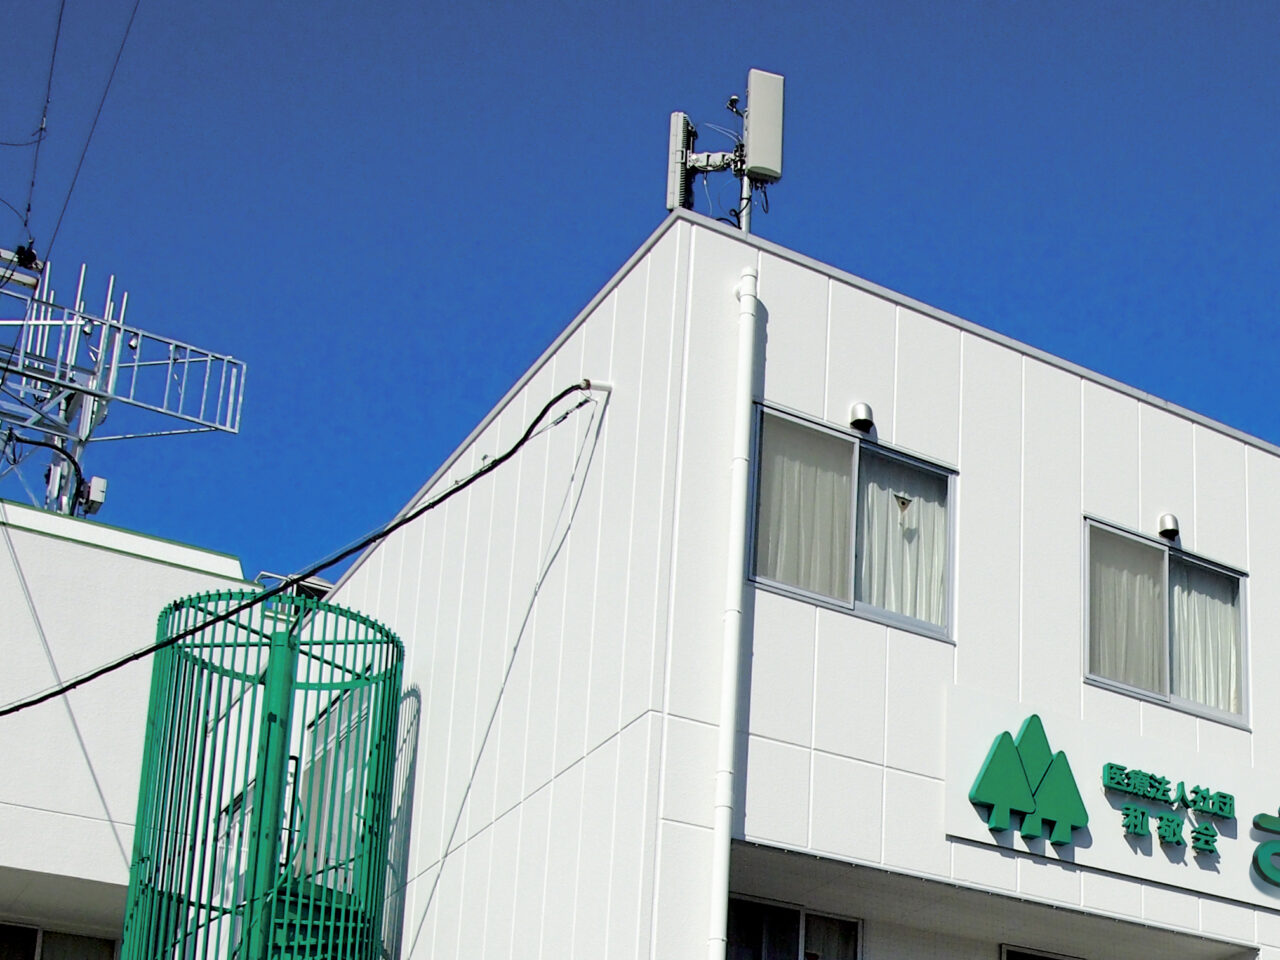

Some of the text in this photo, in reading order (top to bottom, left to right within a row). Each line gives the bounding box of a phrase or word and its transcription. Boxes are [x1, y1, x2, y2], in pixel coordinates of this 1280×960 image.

[1103, 762, 1235, 819] 医療法人社団
[1121, 803, 1218, 854] 和敬会
